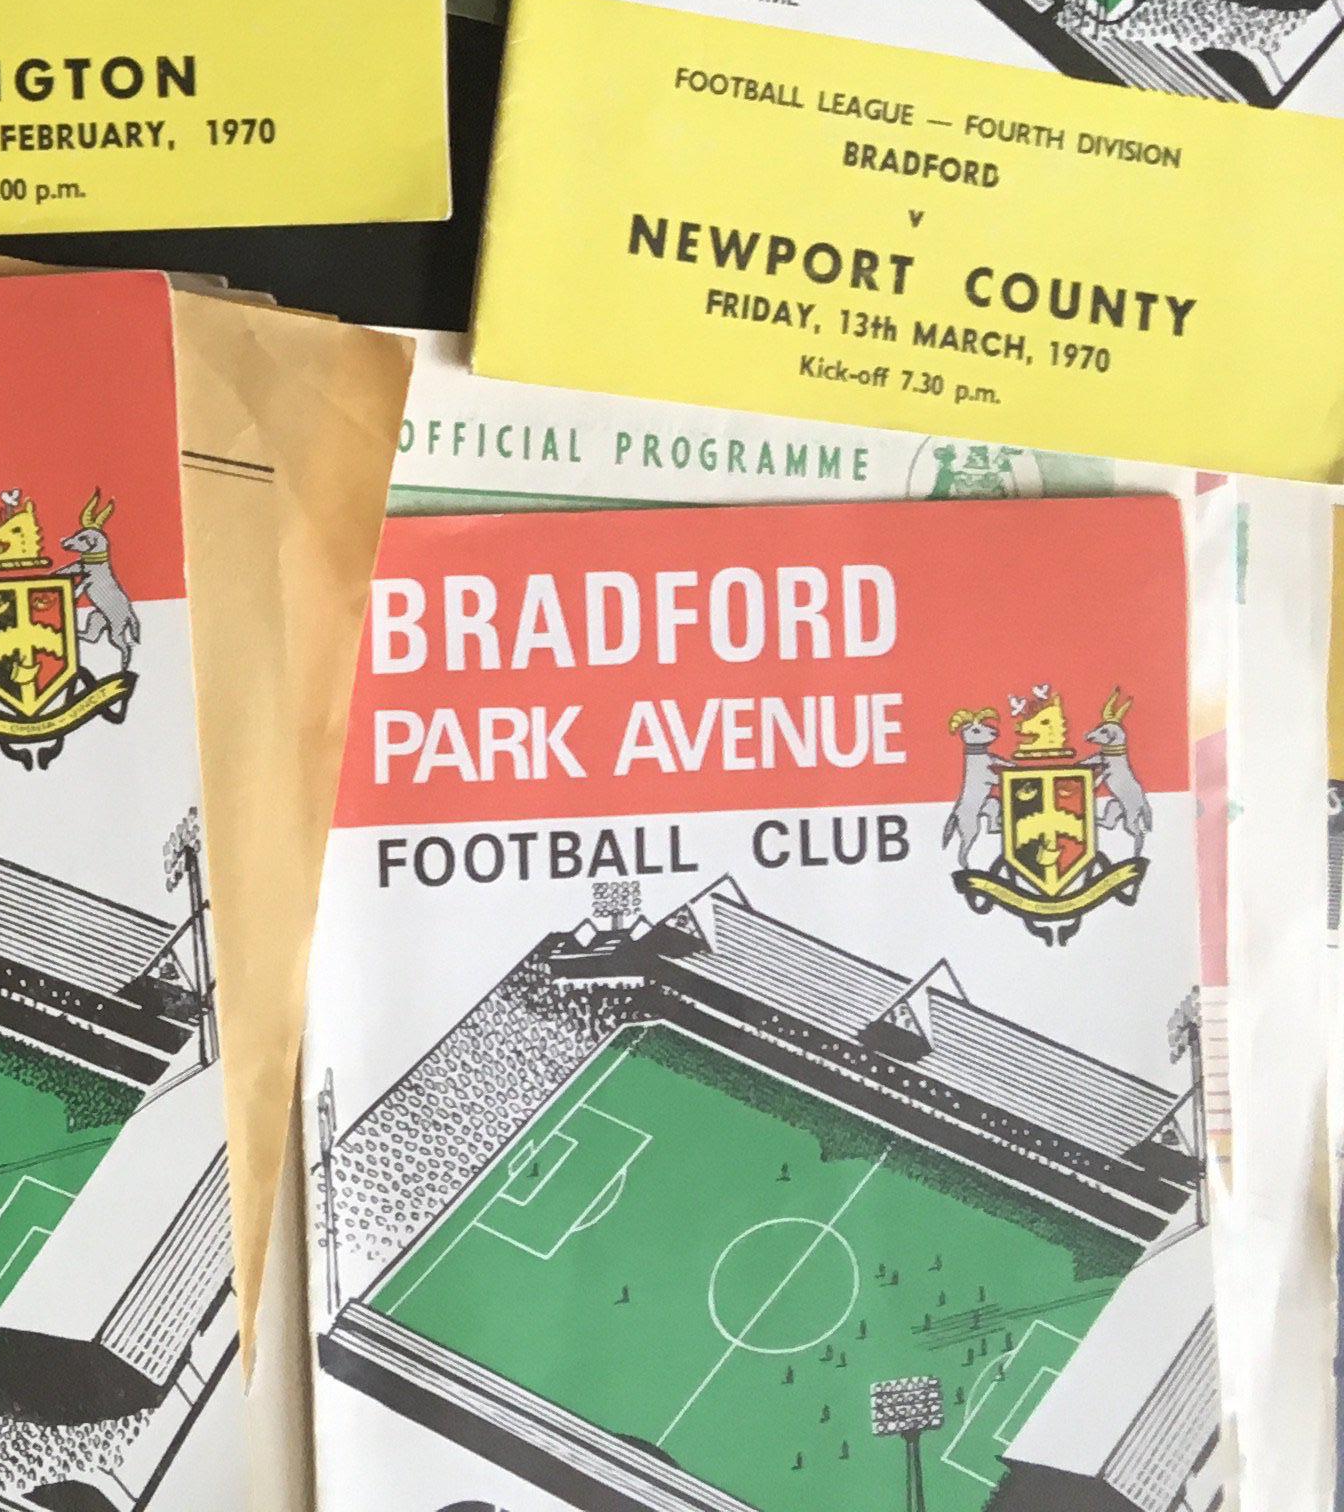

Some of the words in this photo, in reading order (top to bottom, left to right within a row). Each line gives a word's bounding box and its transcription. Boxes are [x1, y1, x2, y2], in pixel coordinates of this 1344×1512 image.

[0, 121, 177, 153] FEBRUARY,
[206, 117, 277, 146] 1970
[674, 67, 805, 112] FOOTBALL
[817, 88, 914, 128] LEAGUE
[963, 113, 1066, 152] FOURTH
[1076, 129, 1182, 170] DIVISION
[36, 182, 87, 207] p.m.
[842, 141, 1000, 190] BRADFORD
[908, 208, 925, 228] v
[627, 213, 916, 297] NEWPORT
[965, 265, 1199, 338] COUNTY
[705, 288, 823, 336] FRIDAY,
[839, 308, 899, 345] 13th
[912, 319, 1034, 366] MARCH,
[1048, 342, 1112, 375] 1970
[799, 355, 891, 389] Kick-off
[900, 370, 945, 398] 7.30
[954, 379, 1003, 409] p.m.
[397, 418, 582, 464] OFFICIAL
[613, 431, 870, 482] PROGRAMME
[371, 563, 899, 676] BRADFORD
[373, 700, 587, 786] PARK
[614, 691, 908, 774] AVENUE
[377, 825, 699, 890] FOOTBALL
[751, 815, 910, 868] CLUB
